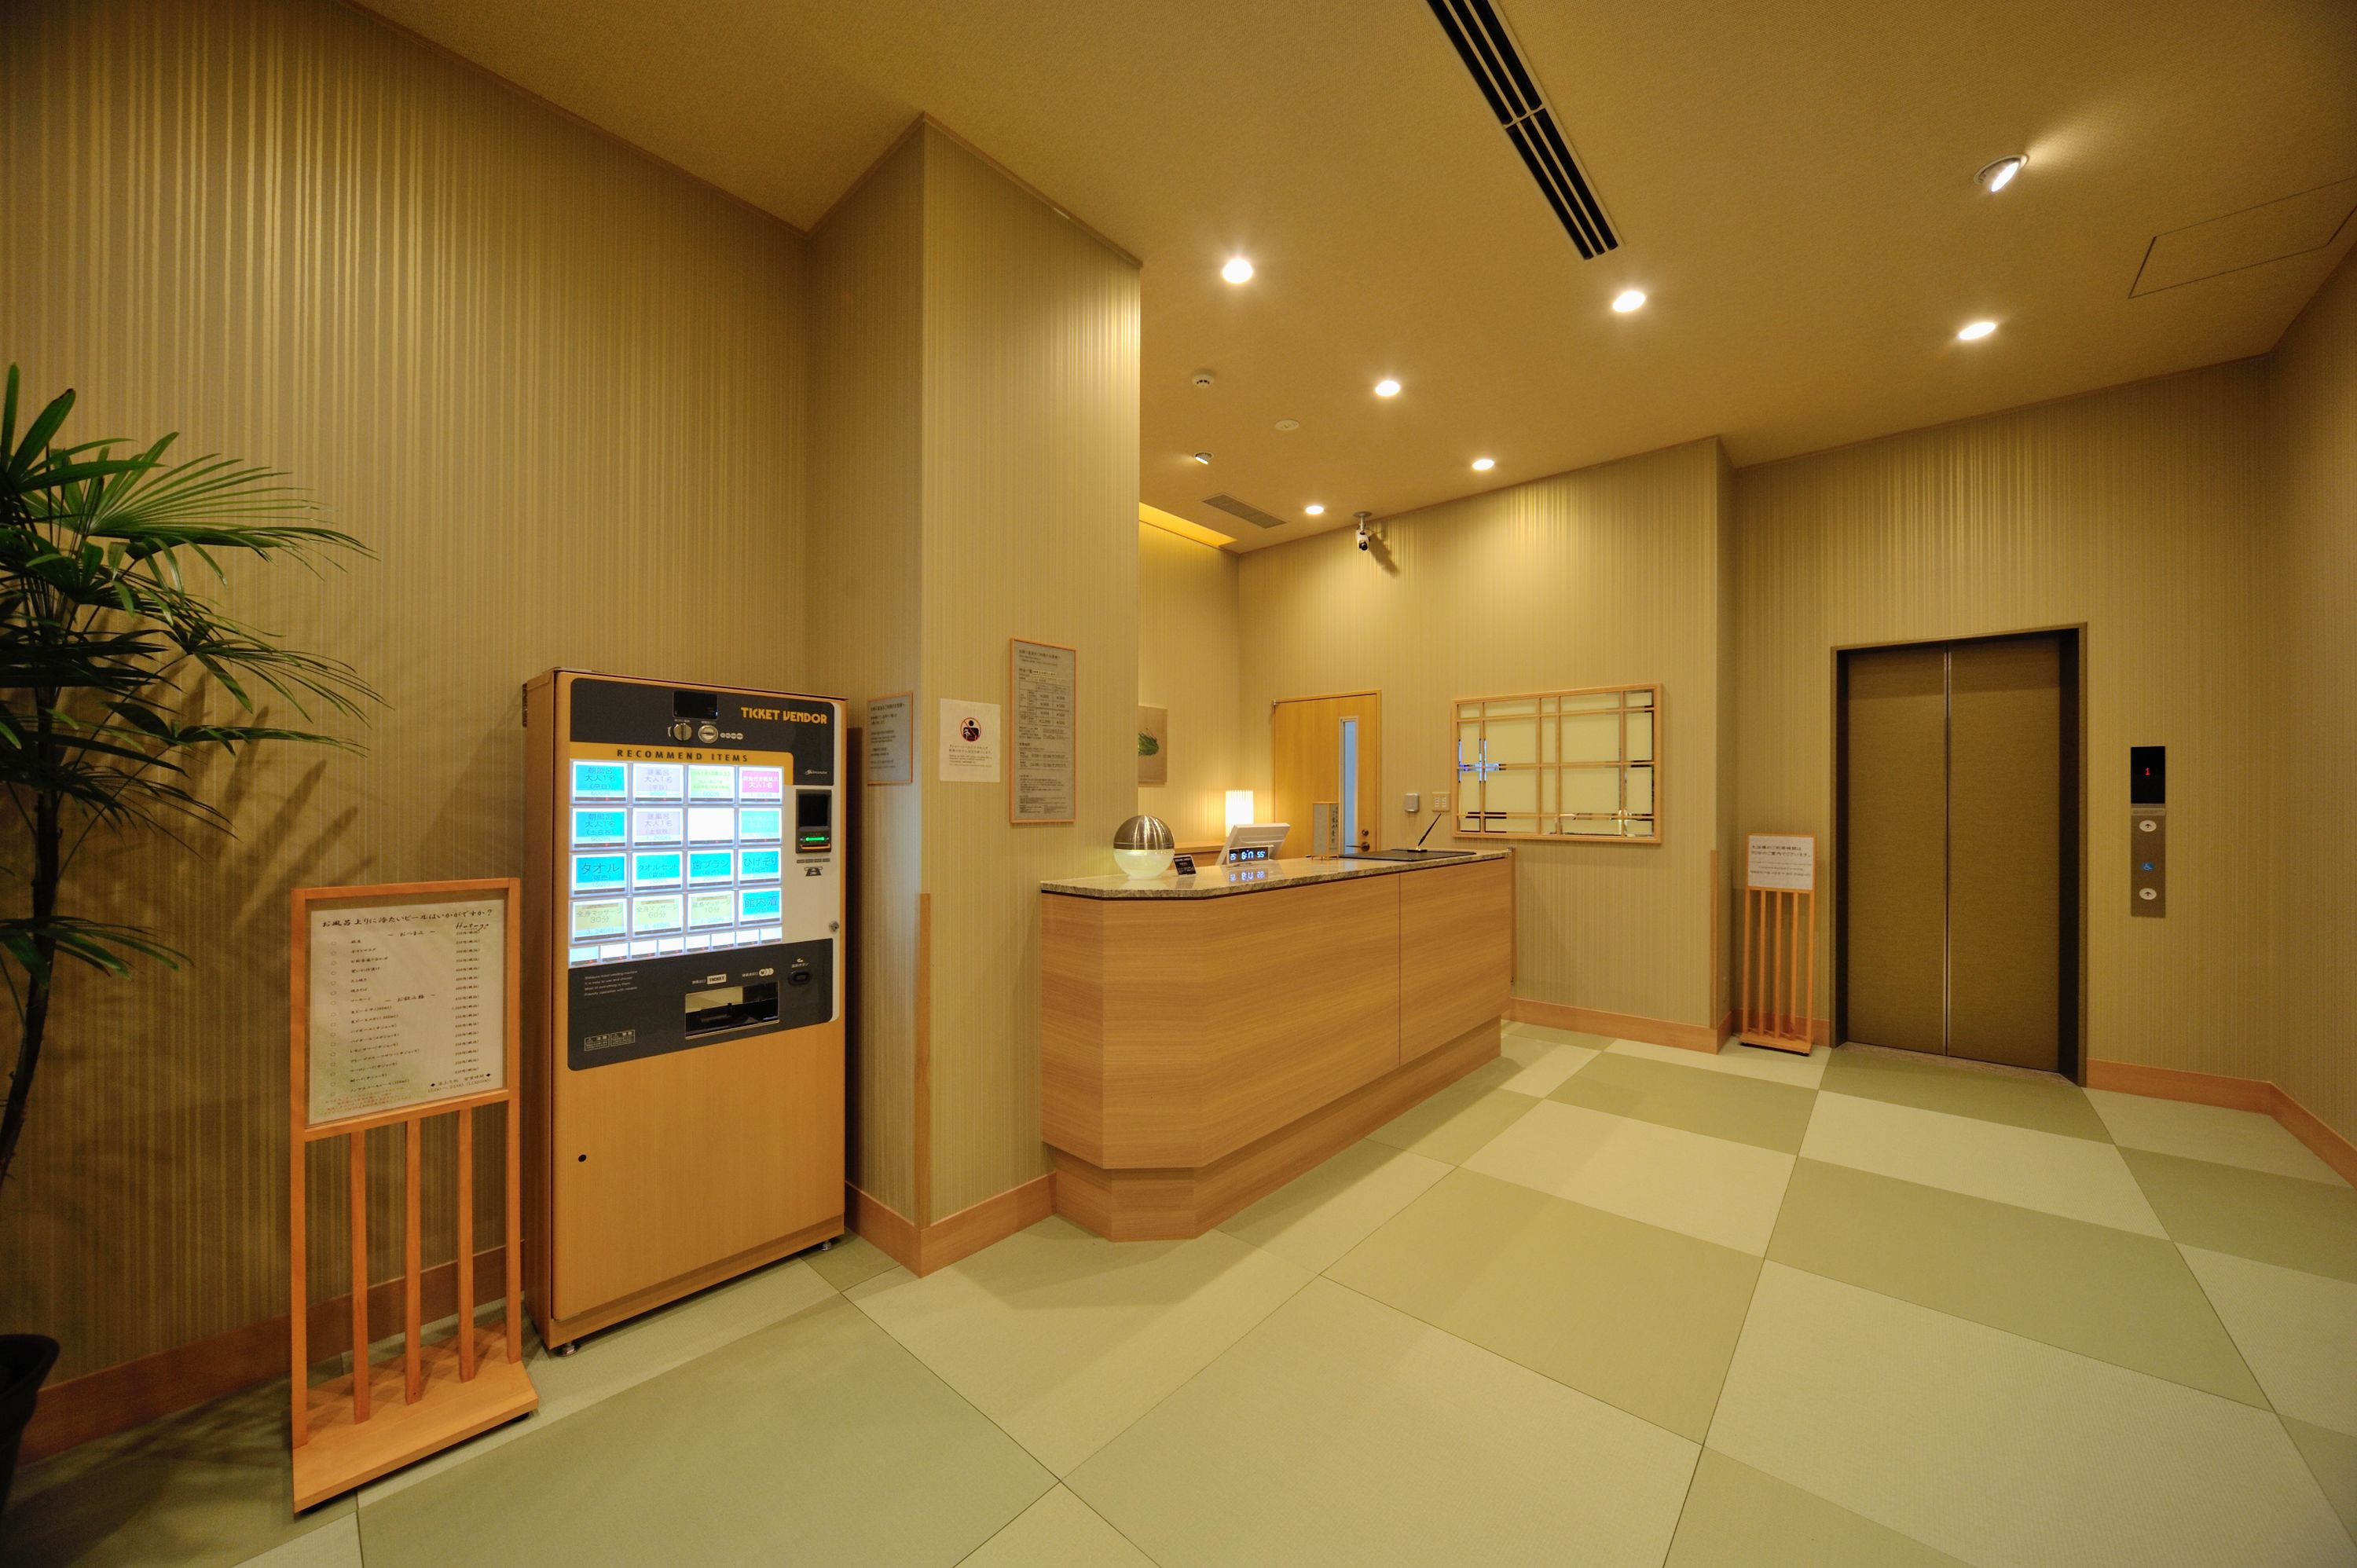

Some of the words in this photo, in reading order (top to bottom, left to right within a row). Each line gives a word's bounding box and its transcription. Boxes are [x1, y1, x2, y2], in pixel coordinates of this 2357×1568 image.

[741, 707, 780, 721] TICKET
[783, 709, 827, 724] VENDOR
[617, 749, 702, 760] RECOMMEND
[711, 753, 748, 762] ITEMS
[2144, 767, 2151, 776] 1
[692, 859, 729, 870] 歯ブラシ
[743, 856, 778, 867] ひげそり
[581, 862, 620, 875] タオル
[639, 863, 678, 872] タオルセット
[576, 908, 623, 918] 全身マッサージ
[636, 904, 678, 914] 全身マッサージ
[589, 915, 610, 924] 30分
